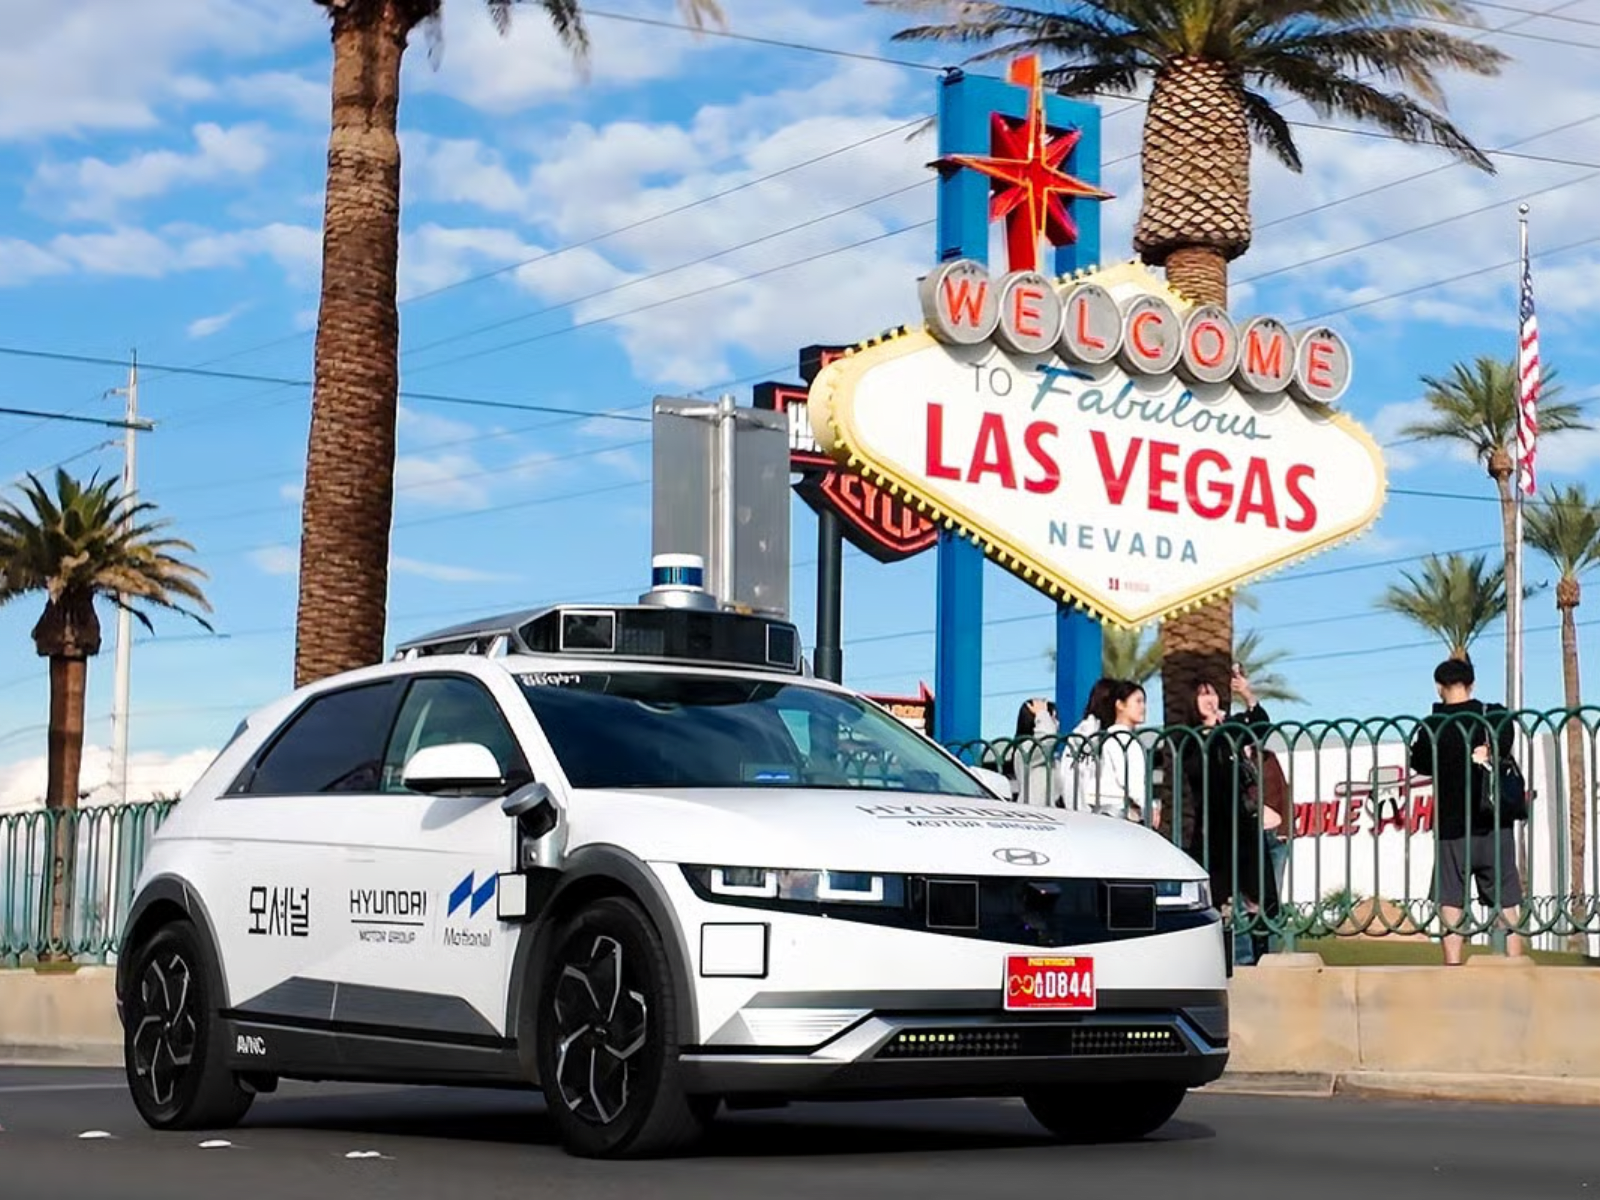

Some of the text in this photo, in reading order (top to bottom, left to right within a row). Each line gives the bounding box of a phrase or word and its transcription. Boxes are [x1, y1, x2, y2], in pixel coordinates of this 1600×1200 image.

[943, 278, 1334, 389] WELCOME
[968, 362, 1272, 440] TO Fabulous
[925, 401, 1061, 495] LAS
[1089, 429, 1317, 533] VEGAS
[1048, 519, 1198, 565] NEVADA
[855, 804, 1057, 822] HYUNDAI
[906, 819, 982, 829] MOTOR
[248, 885, 310, 937] 모셔널
[349, 888, 427, 916] HYUNDAI
[444, 926, 492, 947] Motional
